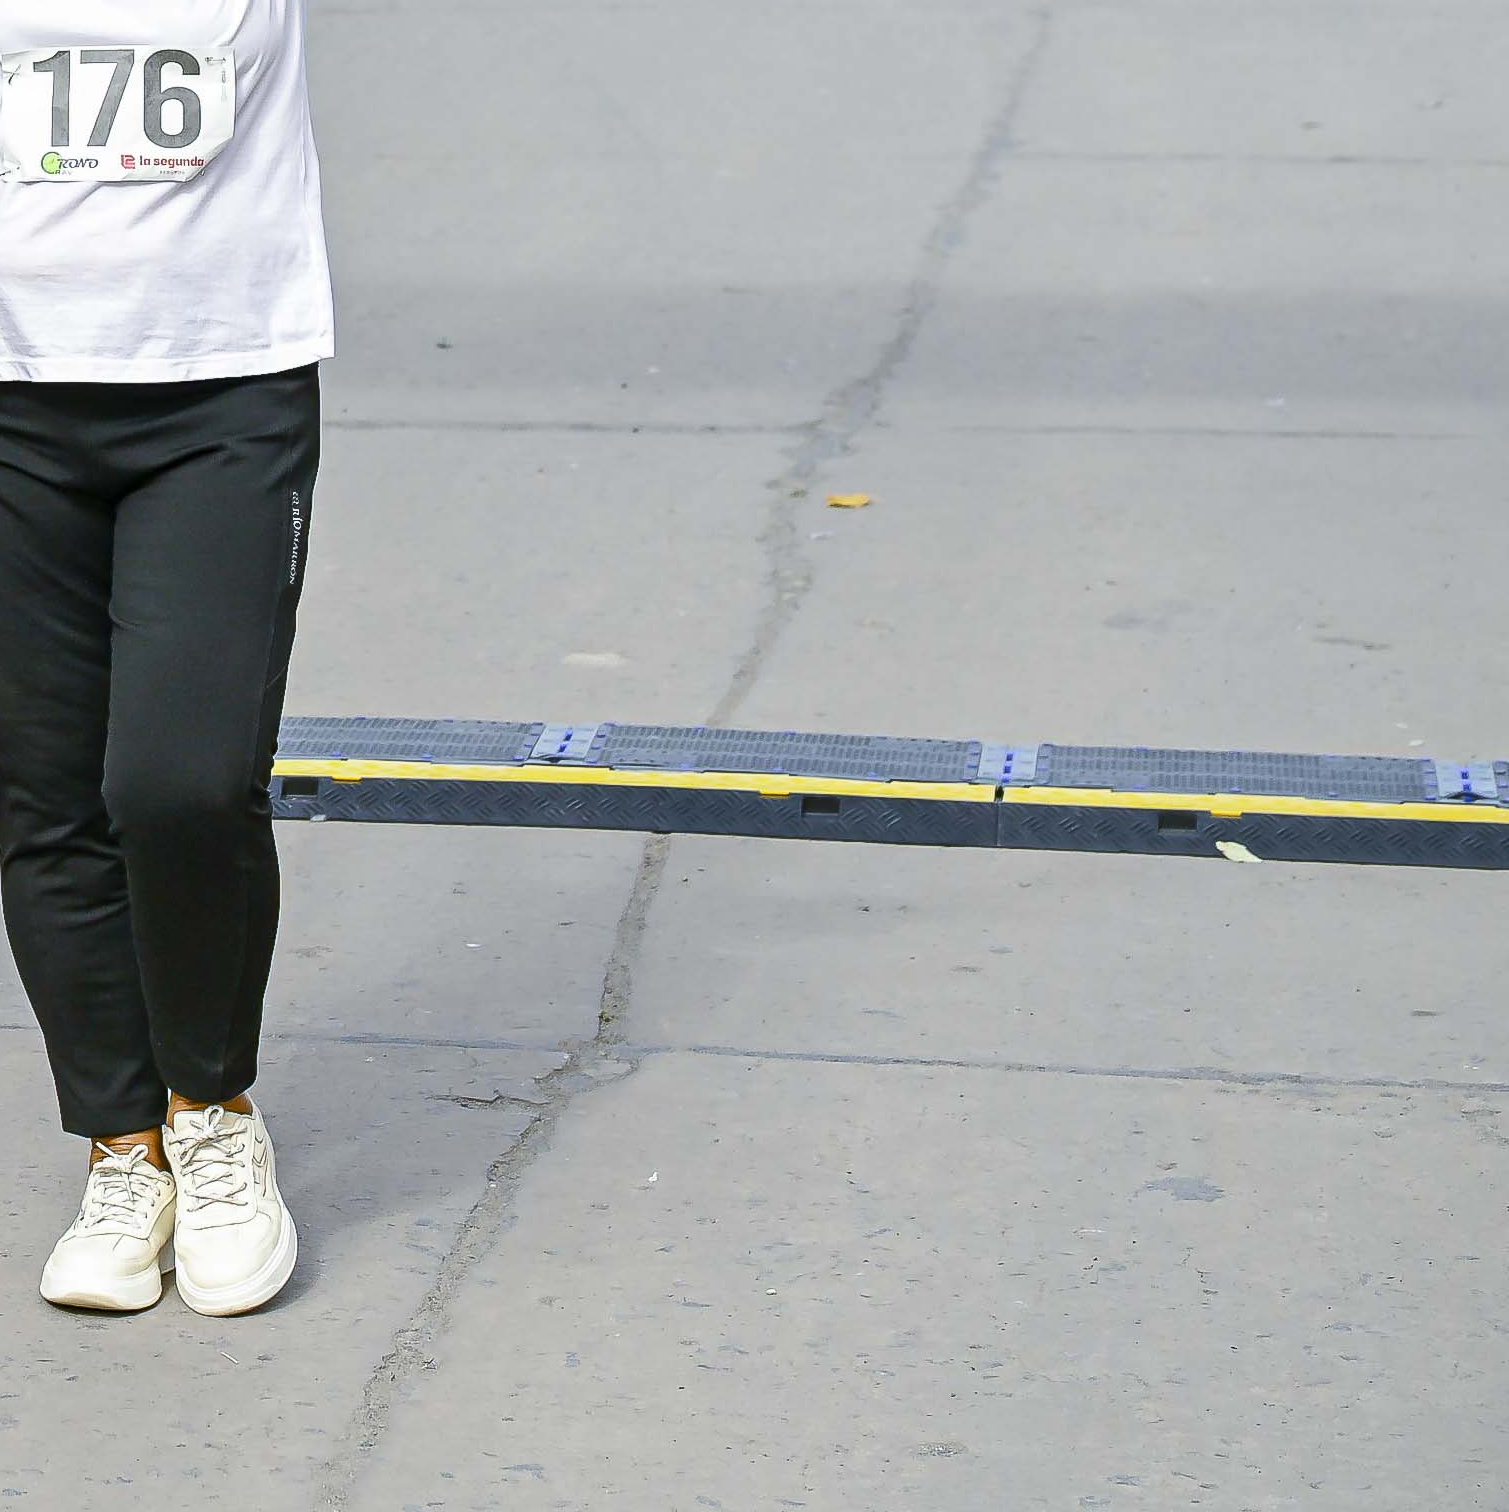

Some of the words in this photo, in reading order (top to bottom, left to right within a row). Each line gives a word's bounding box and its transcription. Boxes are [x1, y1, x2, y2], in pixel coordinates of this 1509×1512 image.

[32, 49, 202, 149] 176
[139, 155, 151, 166] la
[153, 155, 205, 168] segunda
